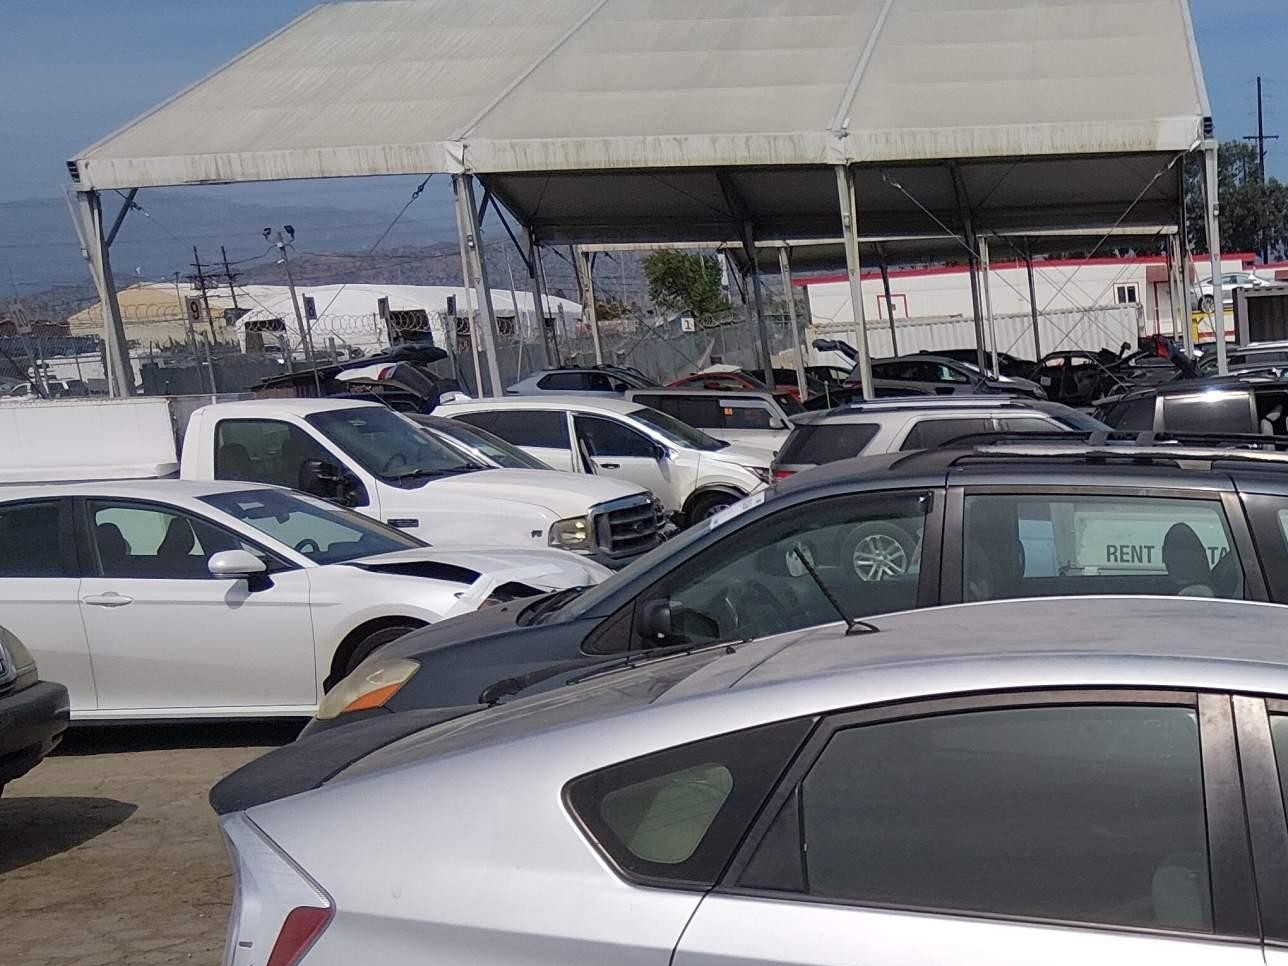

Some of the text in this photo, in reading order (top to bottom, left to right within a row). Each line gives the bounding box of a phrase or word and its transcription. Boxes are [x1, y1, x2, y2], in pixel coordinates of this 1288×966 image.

[190, 301, 199, 320] 9
[684, 320, 691, 330] 1
[1106, 543, 1155, 564] RENT
